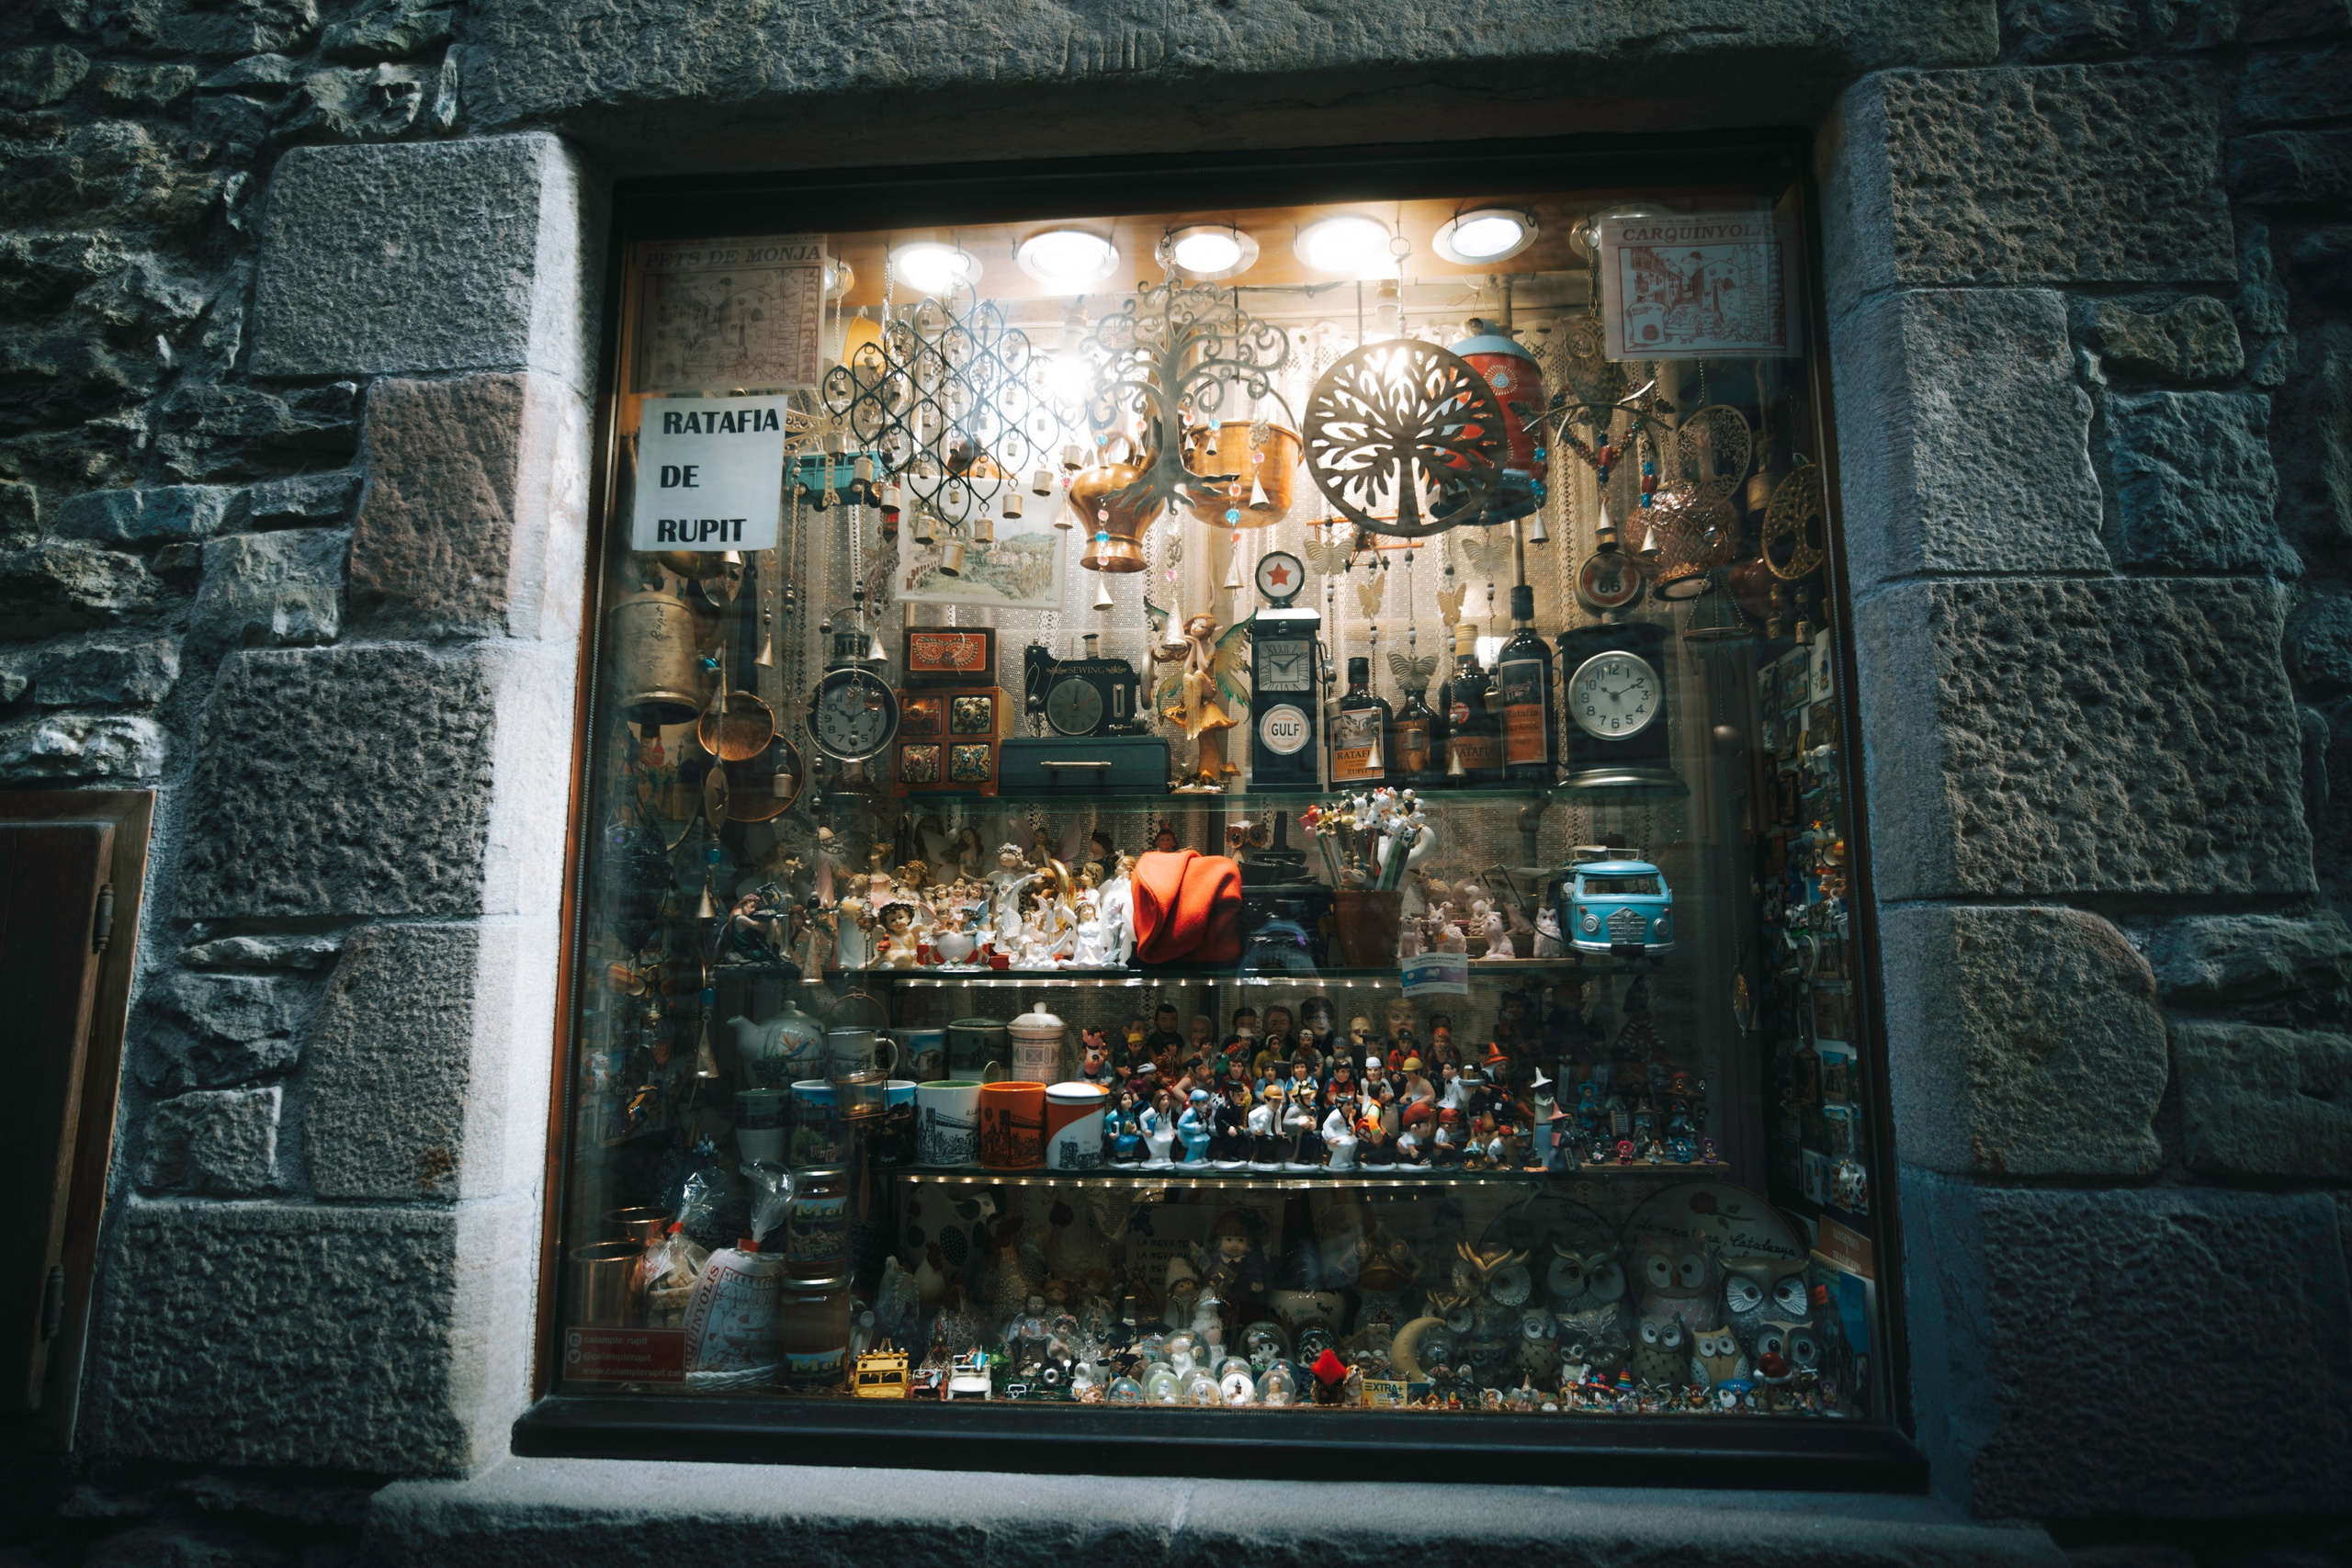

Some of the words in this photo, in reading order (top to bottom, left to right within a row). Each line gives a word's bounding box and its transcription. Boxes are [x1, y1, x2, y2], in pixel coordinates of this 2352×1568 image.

[1623, 223, 1777, 243] CARQUINYOLIS
[644, 251, 701, 268] PETS
[707, 249, 739, 265] DE
[745, 245, 821, 263] MONJA
[663, 409, 780, 434] RATAFIA
[661, 465, 699, 488] DE
[658, 518, 747, 542] RUPIT
[1599, 579, 1622, 593] 66
[650, 605, 667, 642] Rupit
[1068, 666, 1105, 674] SEWING
[1507, 708, 1538, 718] Ratafia
[1272, 723, 1299, 736] GULF
[1338, 750, 1371, 760] RATAFI
[809, 1145, 843, 1161] Rupit
[796, 1203, 843, 1216] Mel
[1559, 1203, 1600, 1235] Rupit
[1636, 1216, 1656, 1231] La
[1660, 1225, 1689, 1238] meva
[1136, 1238, 1148, 1247] LA
[1150, 1239, 1174, 1247] MEVA
[1150, 1252, 1174, 1260] MEVA
[1816, 1260, 1840, 1277] COLLSACA
[685, 1266, 719, 1371] QUINYOLIS
[582, 1352, 651, 1363] @calamplerupit
[791, 1355, 842, 1371] Mel
[582, 1367, 683, 1378] www.calamplerupit.cat
